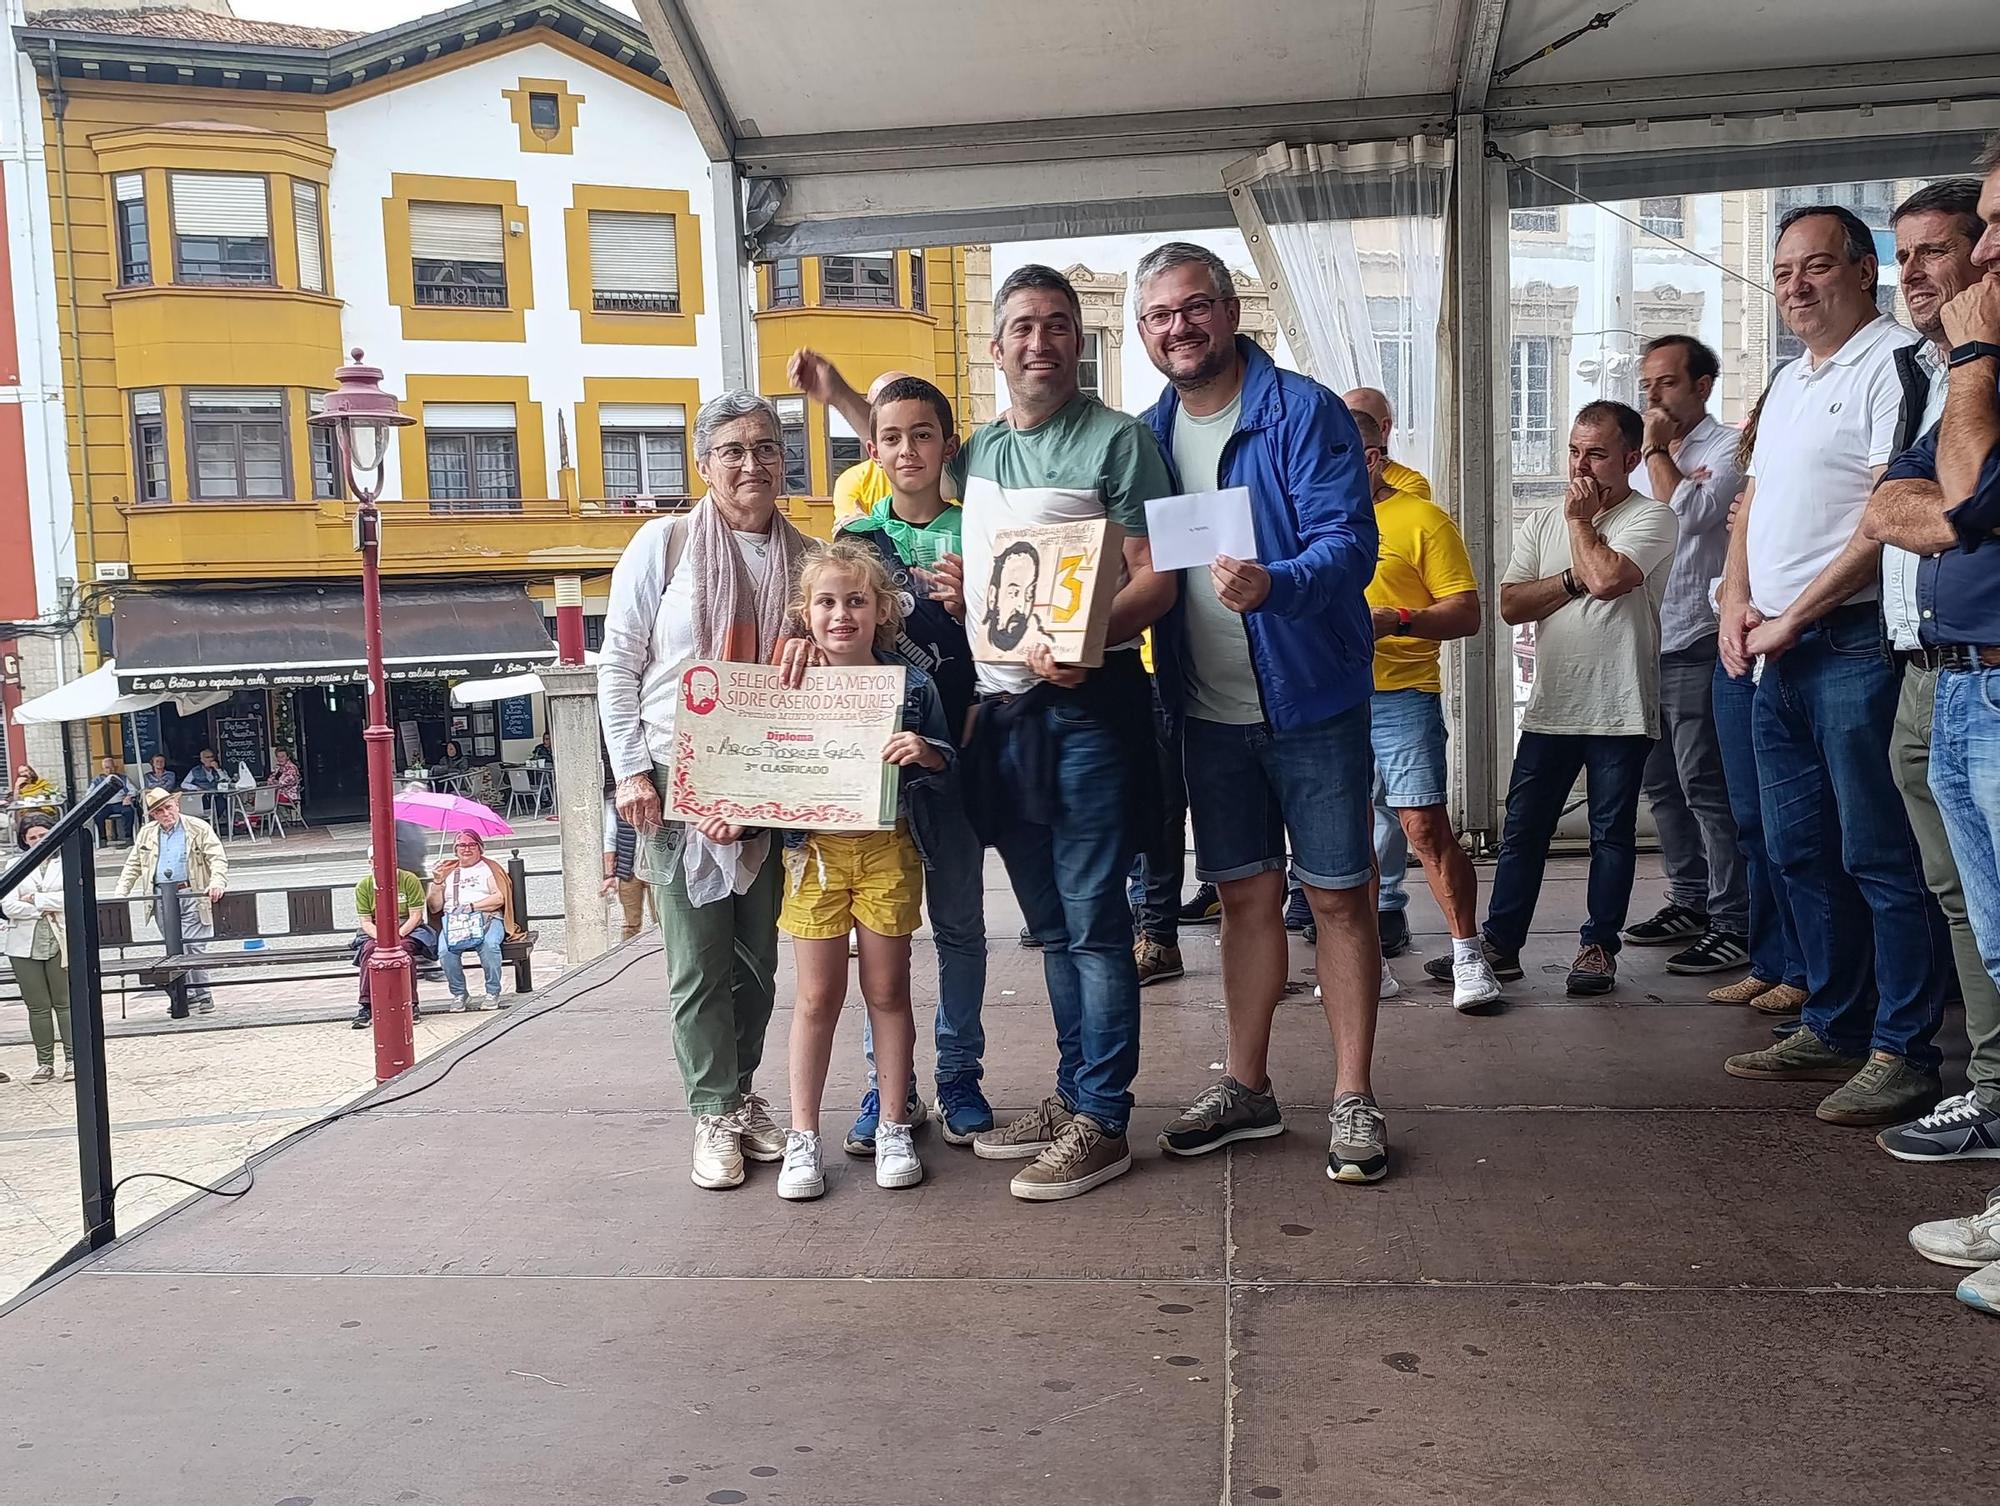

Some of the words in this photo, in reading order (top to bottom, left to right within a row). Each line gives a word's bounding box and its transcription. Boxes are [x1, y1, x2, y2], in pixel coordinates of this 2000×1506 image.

[896, 631, 934, 670] PUMA
[168, 676, 196, 689] Botica
[729, 672, 802, 691] SELEICI
[805, 676, 824, 691] DE
[826, 676, 844, 690] LA
[845, 675, 896, 690] MEYOR
[727, 690, 768, 708] SIDRE
[769, 693, 820, 709] CASERO
[822, 693, 896, 710] D'ASTURIES
[766, 731, 814, 743] Diploma
[760, 763, 830, 775] CLASIFICADO
